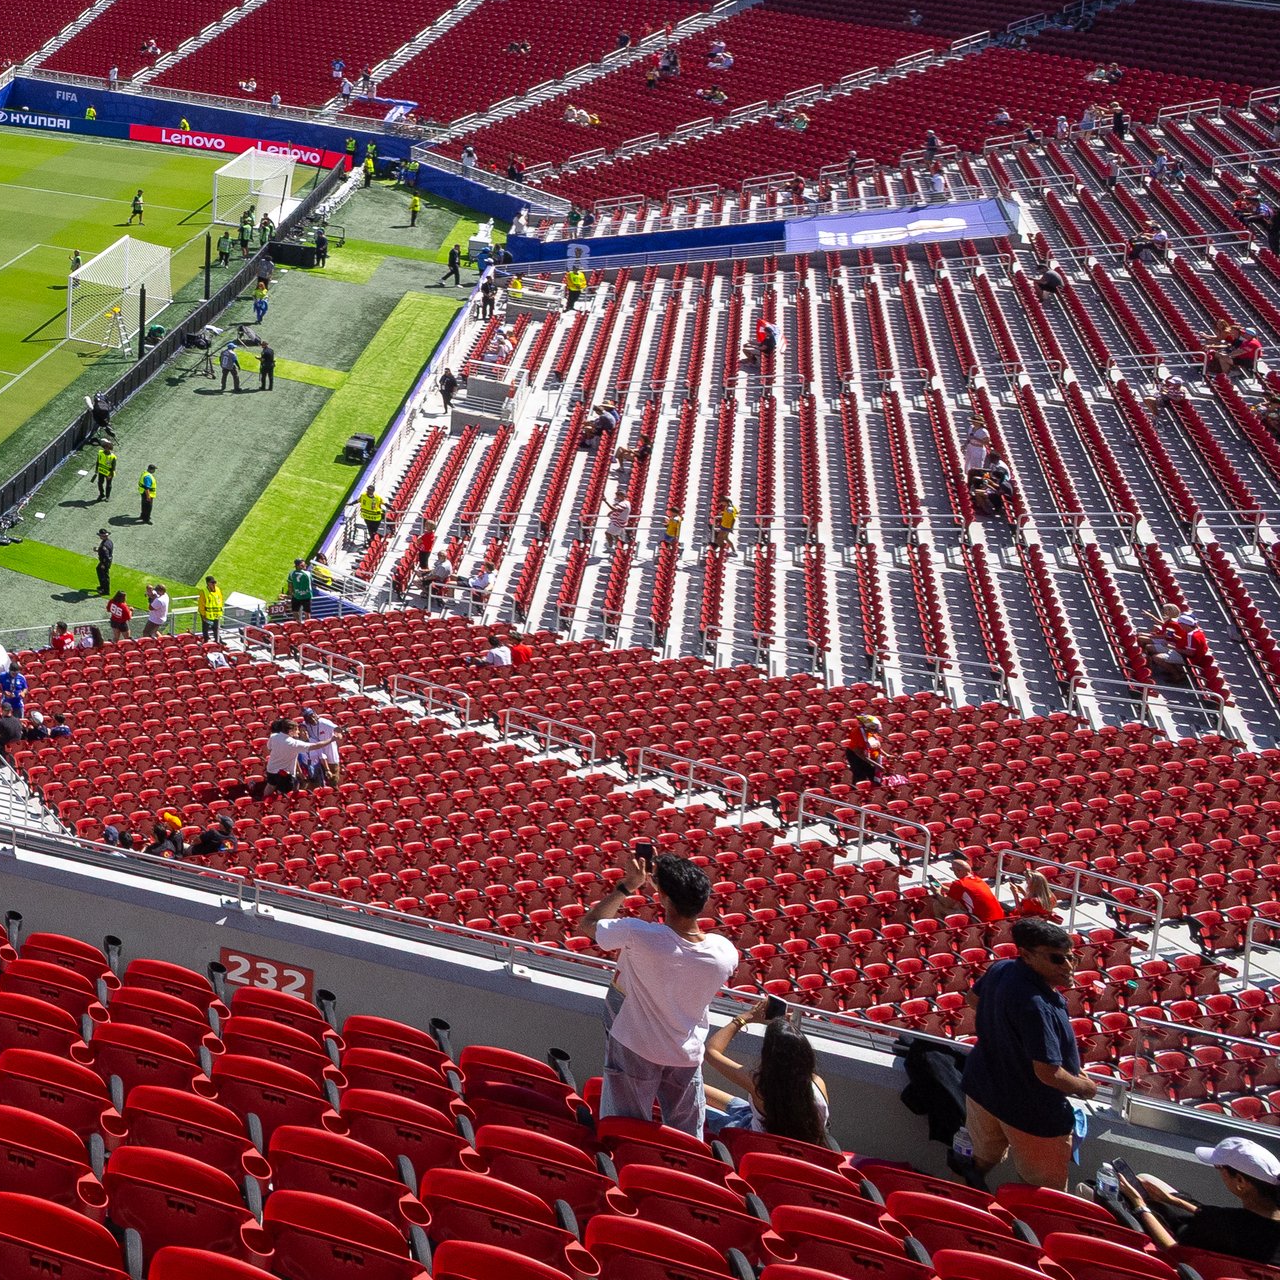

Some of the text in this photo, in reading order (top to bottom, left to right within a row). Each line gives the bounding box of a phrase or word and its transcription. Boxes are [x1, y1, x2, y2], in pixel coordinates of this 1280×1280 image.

[56, 90, 78, 103] FIFA
[11, 113, 71, 129] HYUNDAI
[161, 129, 226, 150] Lenovo
[257, 141, 321, 163] Lenovo
[271, 605, 285, 614] 130
[226, 955, 306, 999] 232
